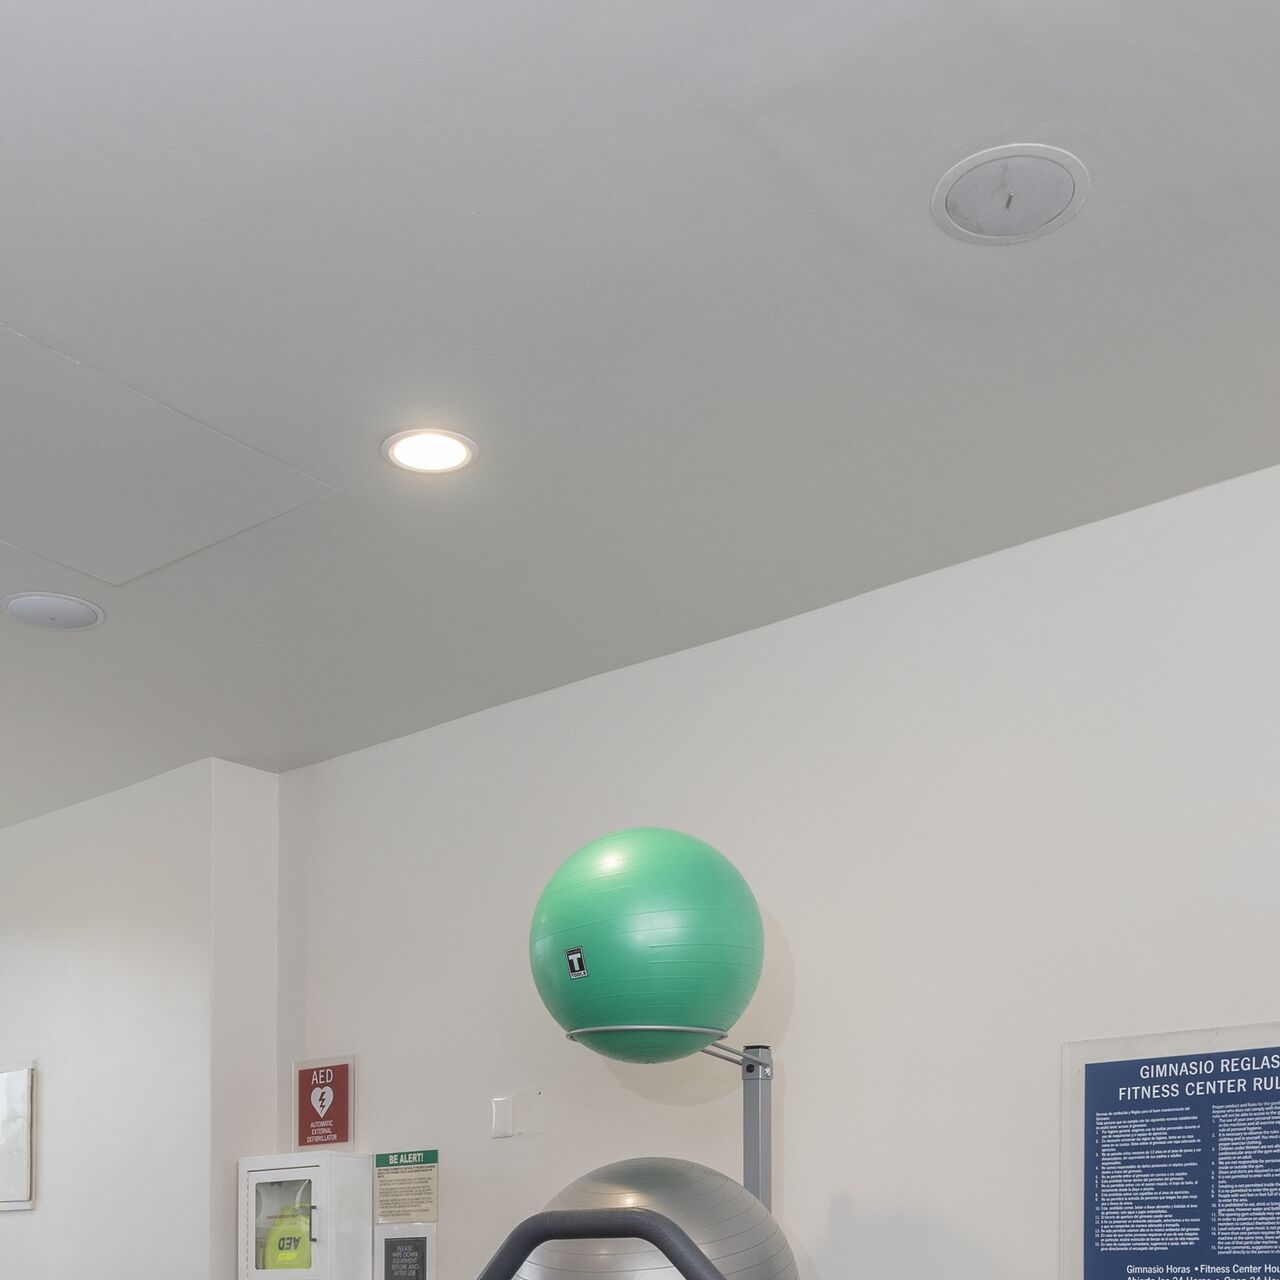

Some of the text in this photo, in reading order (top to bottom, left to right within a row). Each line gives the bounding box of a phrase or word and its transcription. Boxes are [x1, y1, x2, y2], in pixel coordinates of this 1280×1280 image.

[1139, 1054, 1280, 1079] GIMNASIO REGLAS
[311, 1068, 334, 1085] AED
[1119, 1083, 1180, 1101] FITNESS
[1185, 1078, 1247, 1096] CENTER
[310, 1120, 334, 1128] AUTOMATIC
[311, 1127, 333, 1136] EXTERNAL
[306, 1134, 338, 1143] DEFIBRILLATOR
[389, 1152, 424, 1164] BE ALERT!
[278, 1236, 301, 1251] AED
[1126, 1264, 1165, 1274] Gimnasio
[1166, 1264, 1191, 1274] Horas
[1199, 1264, 1231, 1274] Fitness
[1232, 1263, 1262, 1274] Center
